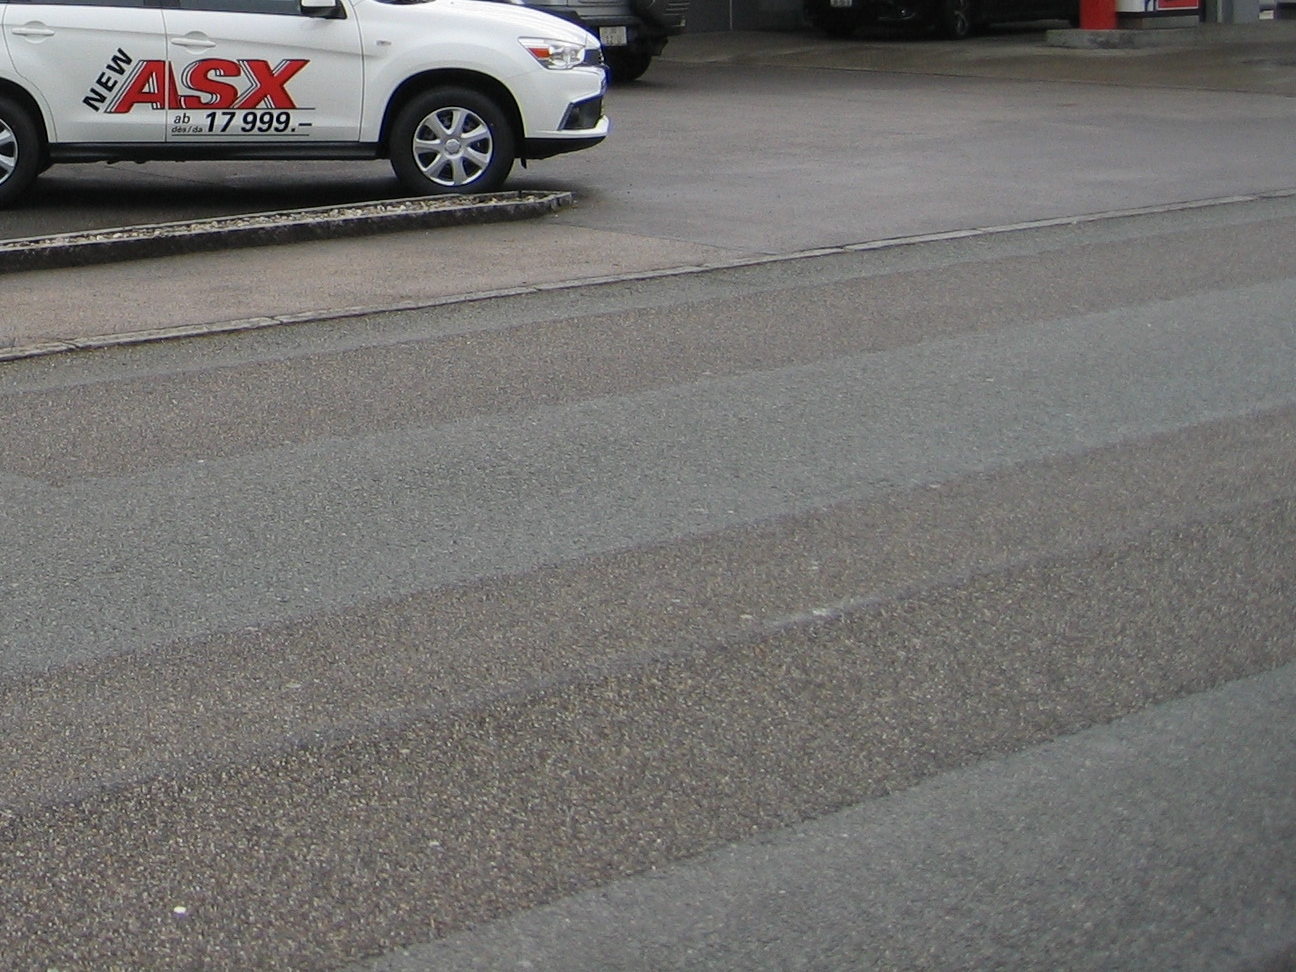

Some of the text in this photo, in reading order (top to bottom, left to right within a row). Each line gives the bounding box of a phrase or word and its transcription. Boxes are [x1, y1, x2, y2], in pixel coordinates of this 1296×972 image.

[82, 47, 134, 113] NEW
[104, 58, 311, 114] ASX
[173, 112, 191, 124] ab
[205, 111, 236, 133] 17
